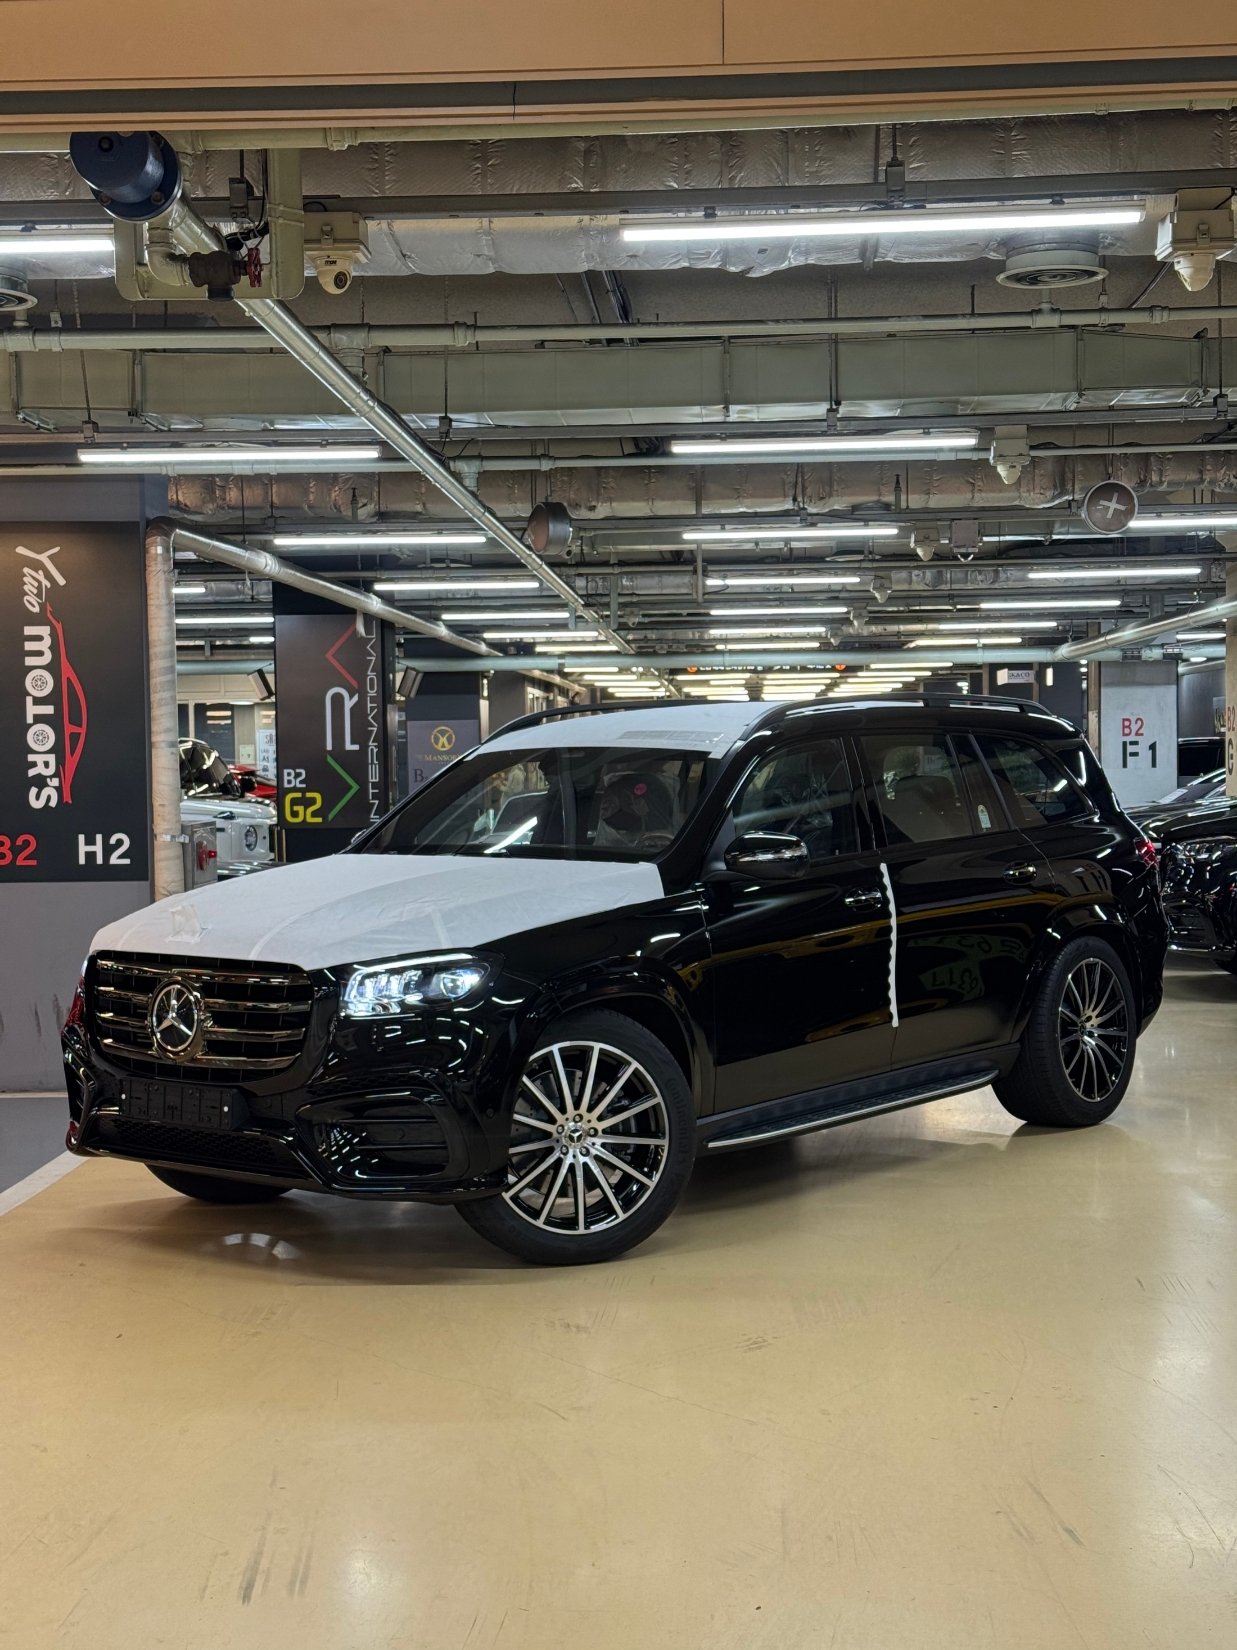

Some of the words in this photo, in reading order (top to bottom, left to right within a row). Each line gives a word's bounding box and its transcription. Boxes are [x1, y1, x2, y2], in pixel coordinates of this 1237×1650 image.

[365, 620, 380, 821] INTERNATIONAL
[1121, 717, 1145, 737] B2
[1227, 706, 1237, 732] B2
[283, 768, 307, 788] B2
[284, 792, 323, 823] G2
[78, 832, 132, 866] H2
